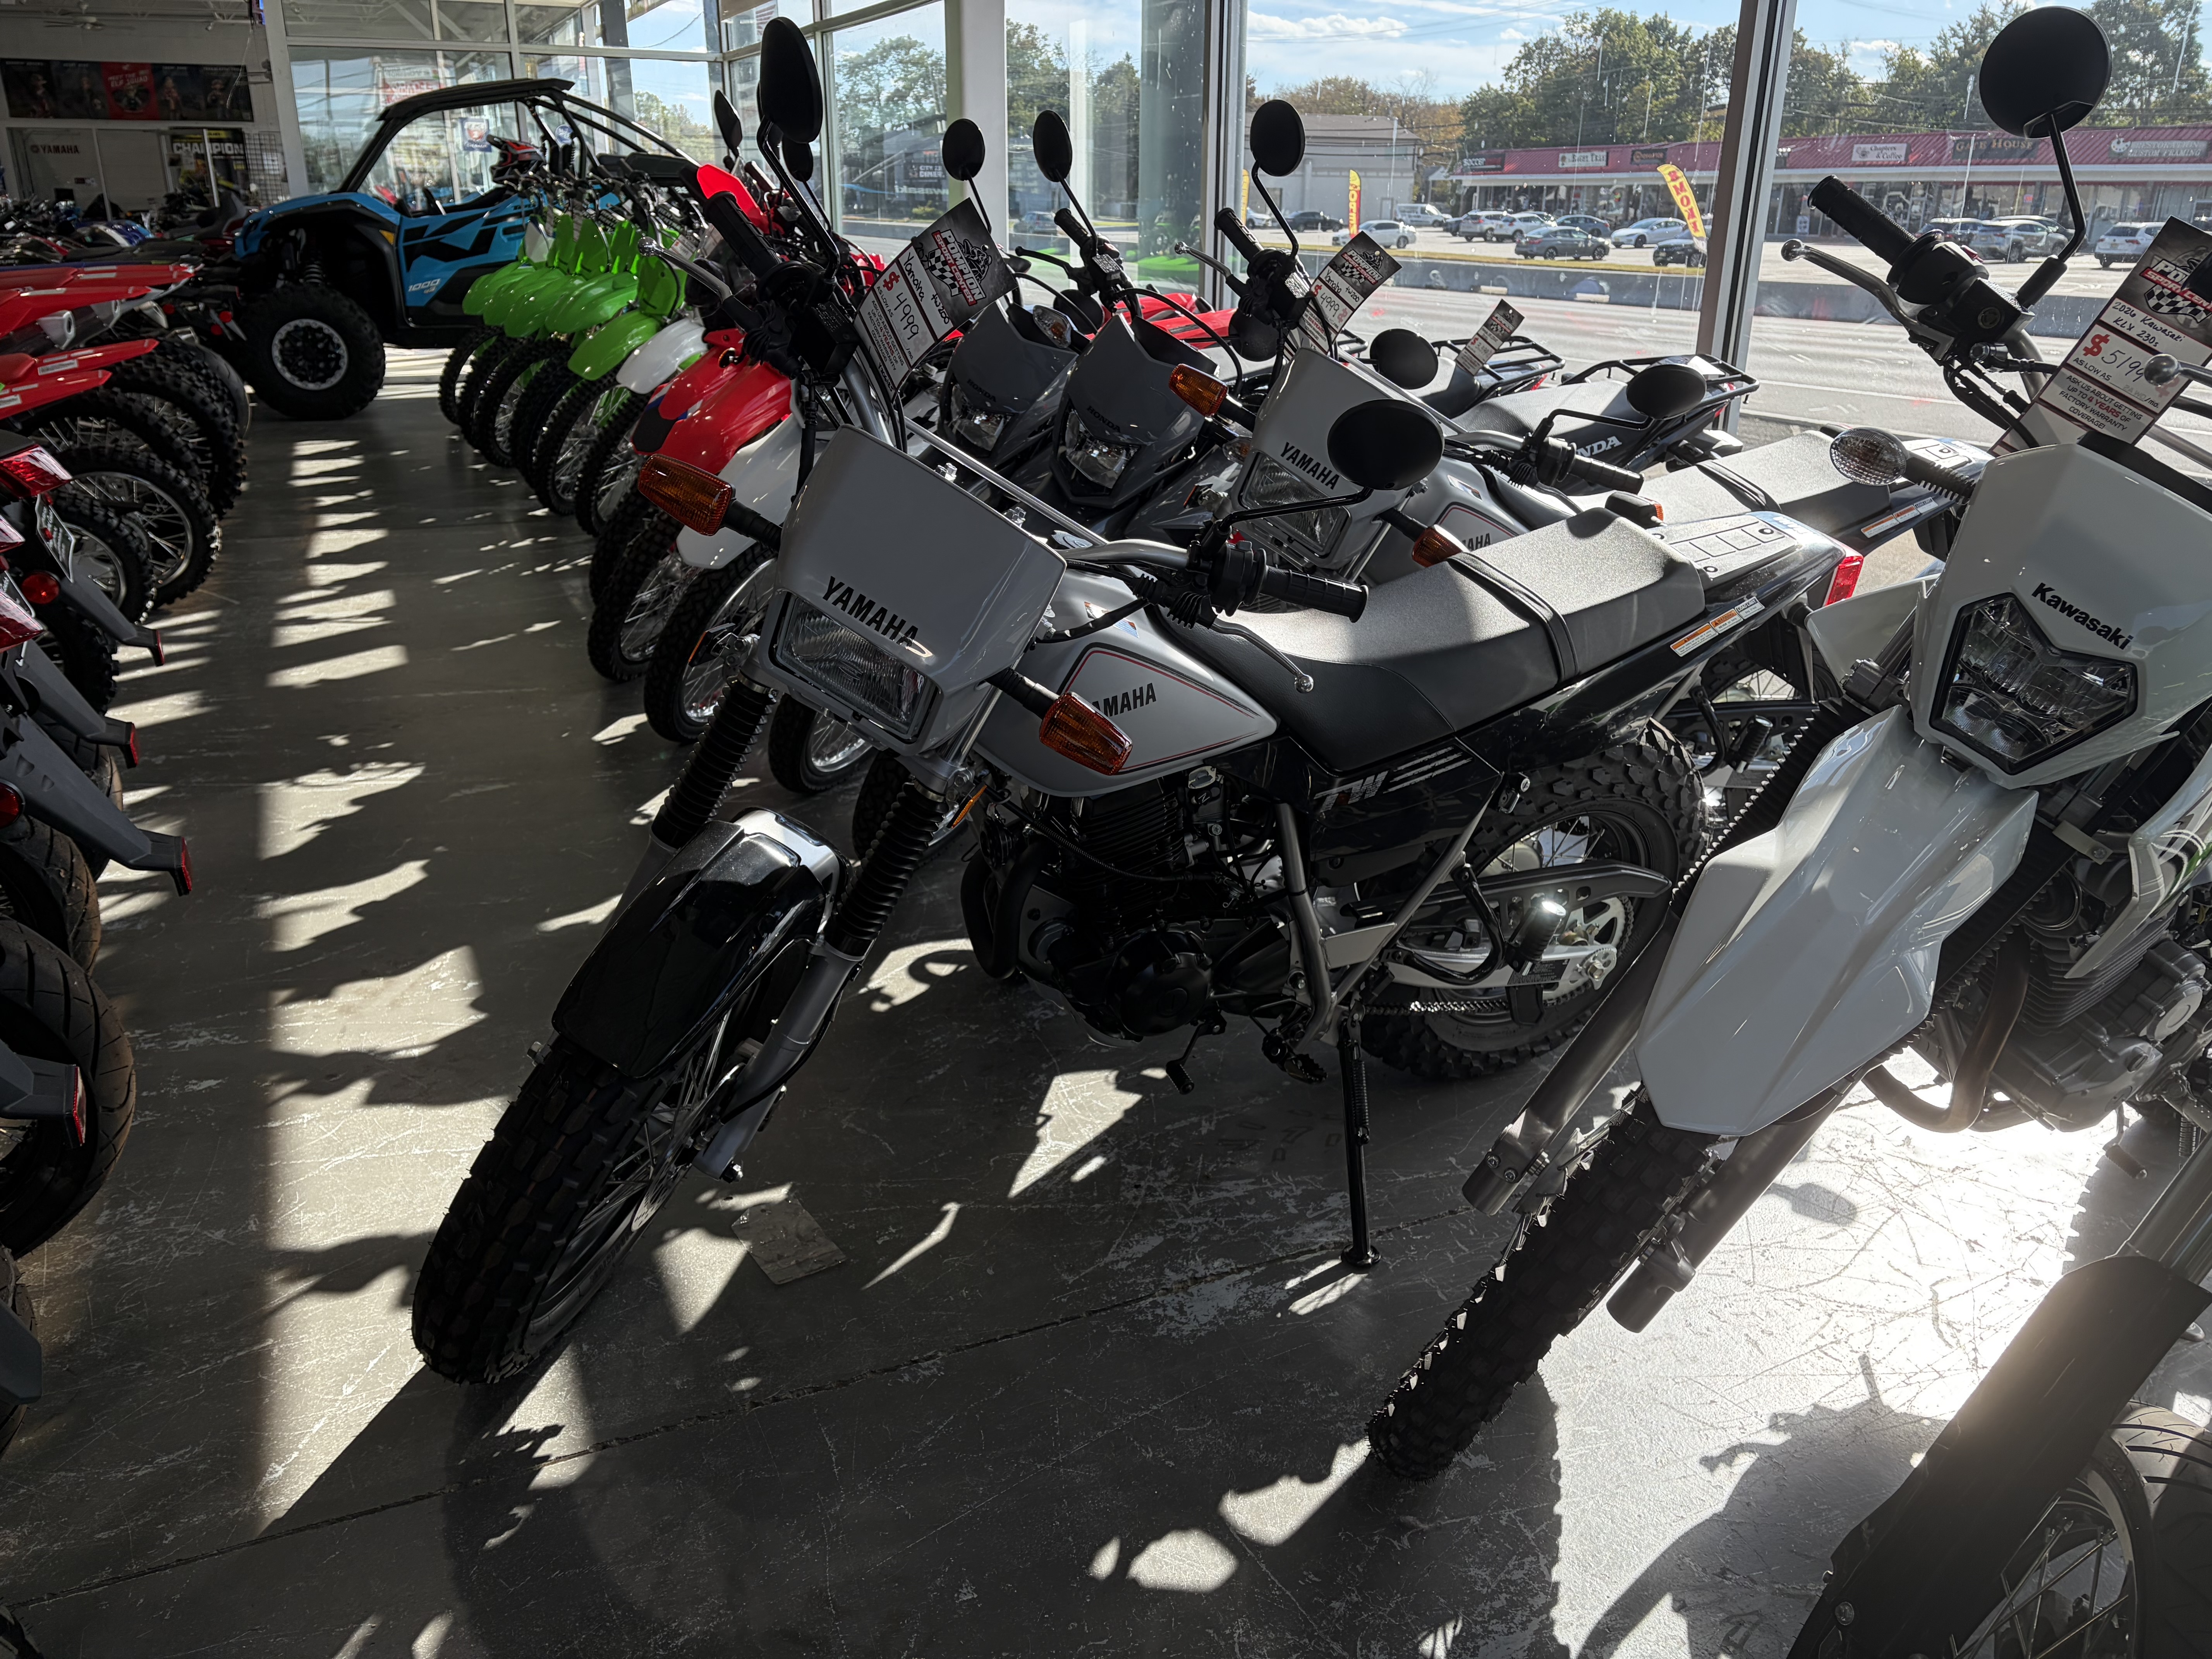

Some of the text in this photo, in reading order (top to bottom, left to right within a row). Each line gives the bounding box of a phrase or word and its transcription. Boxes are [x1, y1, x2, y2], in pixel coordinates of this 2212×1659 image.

[41, 145, 79, 153] YAMAHA
[1991, 139, 2033, 149] HOUSE
[1463, 158, 1486, 166] SOCCER
[903, 252, 924, 302] Yamaha
[934, 234, 975, 303] SPORT CENTER
[941, 230, 986, 301] POMPTON
[1324, 269, 1341, 293] Yamaha
[1347, 250, 1383, 280] POMPTON
[409, 278, 440, 292] 1000
[877, 286, 883, 295] AS
[881, 294, 889, 308] LOW
[887, 309, 894, 318] AS
[883, 271, 919, 340] $ 4999
[1320, 293, 1340, 317] 4999
[871, 309, 876, 318] UP
[876, 318, 880, 327] TO
[883, 332, 894, 356] YEARS
[2112, 302, 2185, 342] 2026 Kawasaki
[2113, 316, 2135, 331] KLX
[867, 311, 896, 371] FACTORY WARRANTY
[882, 321, 892, 340] ABOUT
[891, 340, 904, 366] GETTING
[2083, 334, 2110, 356] $
[2073, 357, 2085, 366] AS
[2084, 362, 2102, 375] LOW
[2099, 372, 2112, 381] AS
[967, 379, 997, 402] HONDA
[2066, 375, 2143, 421] ASK US ABOUT GETTING
[2067, 385, 2078, 393] UP
[2079, 391, 2088, 400] TO
[2095, 398, 2122, 419] YEARS
[2120, 414, 2131, 422] OF
[1087, 405, 1121, 431] HONDA
[2059, 390, 2128, 431] FACTORY WARRANTY
[2069, 406, 2106, 429] COVERAGE!
[1575, 435, 1622, 459] NDA
[1280, 442, 1340, 490] YAMAHA
[1462, 533, 1491, 551] AHA
[822, 576, 919, 646] YAMAHA
[2032, 582, 2134, 650] Kawasaki
[1092, 682, 1156, 717] MAHA
[1314, 771, 1389, 812] TW
